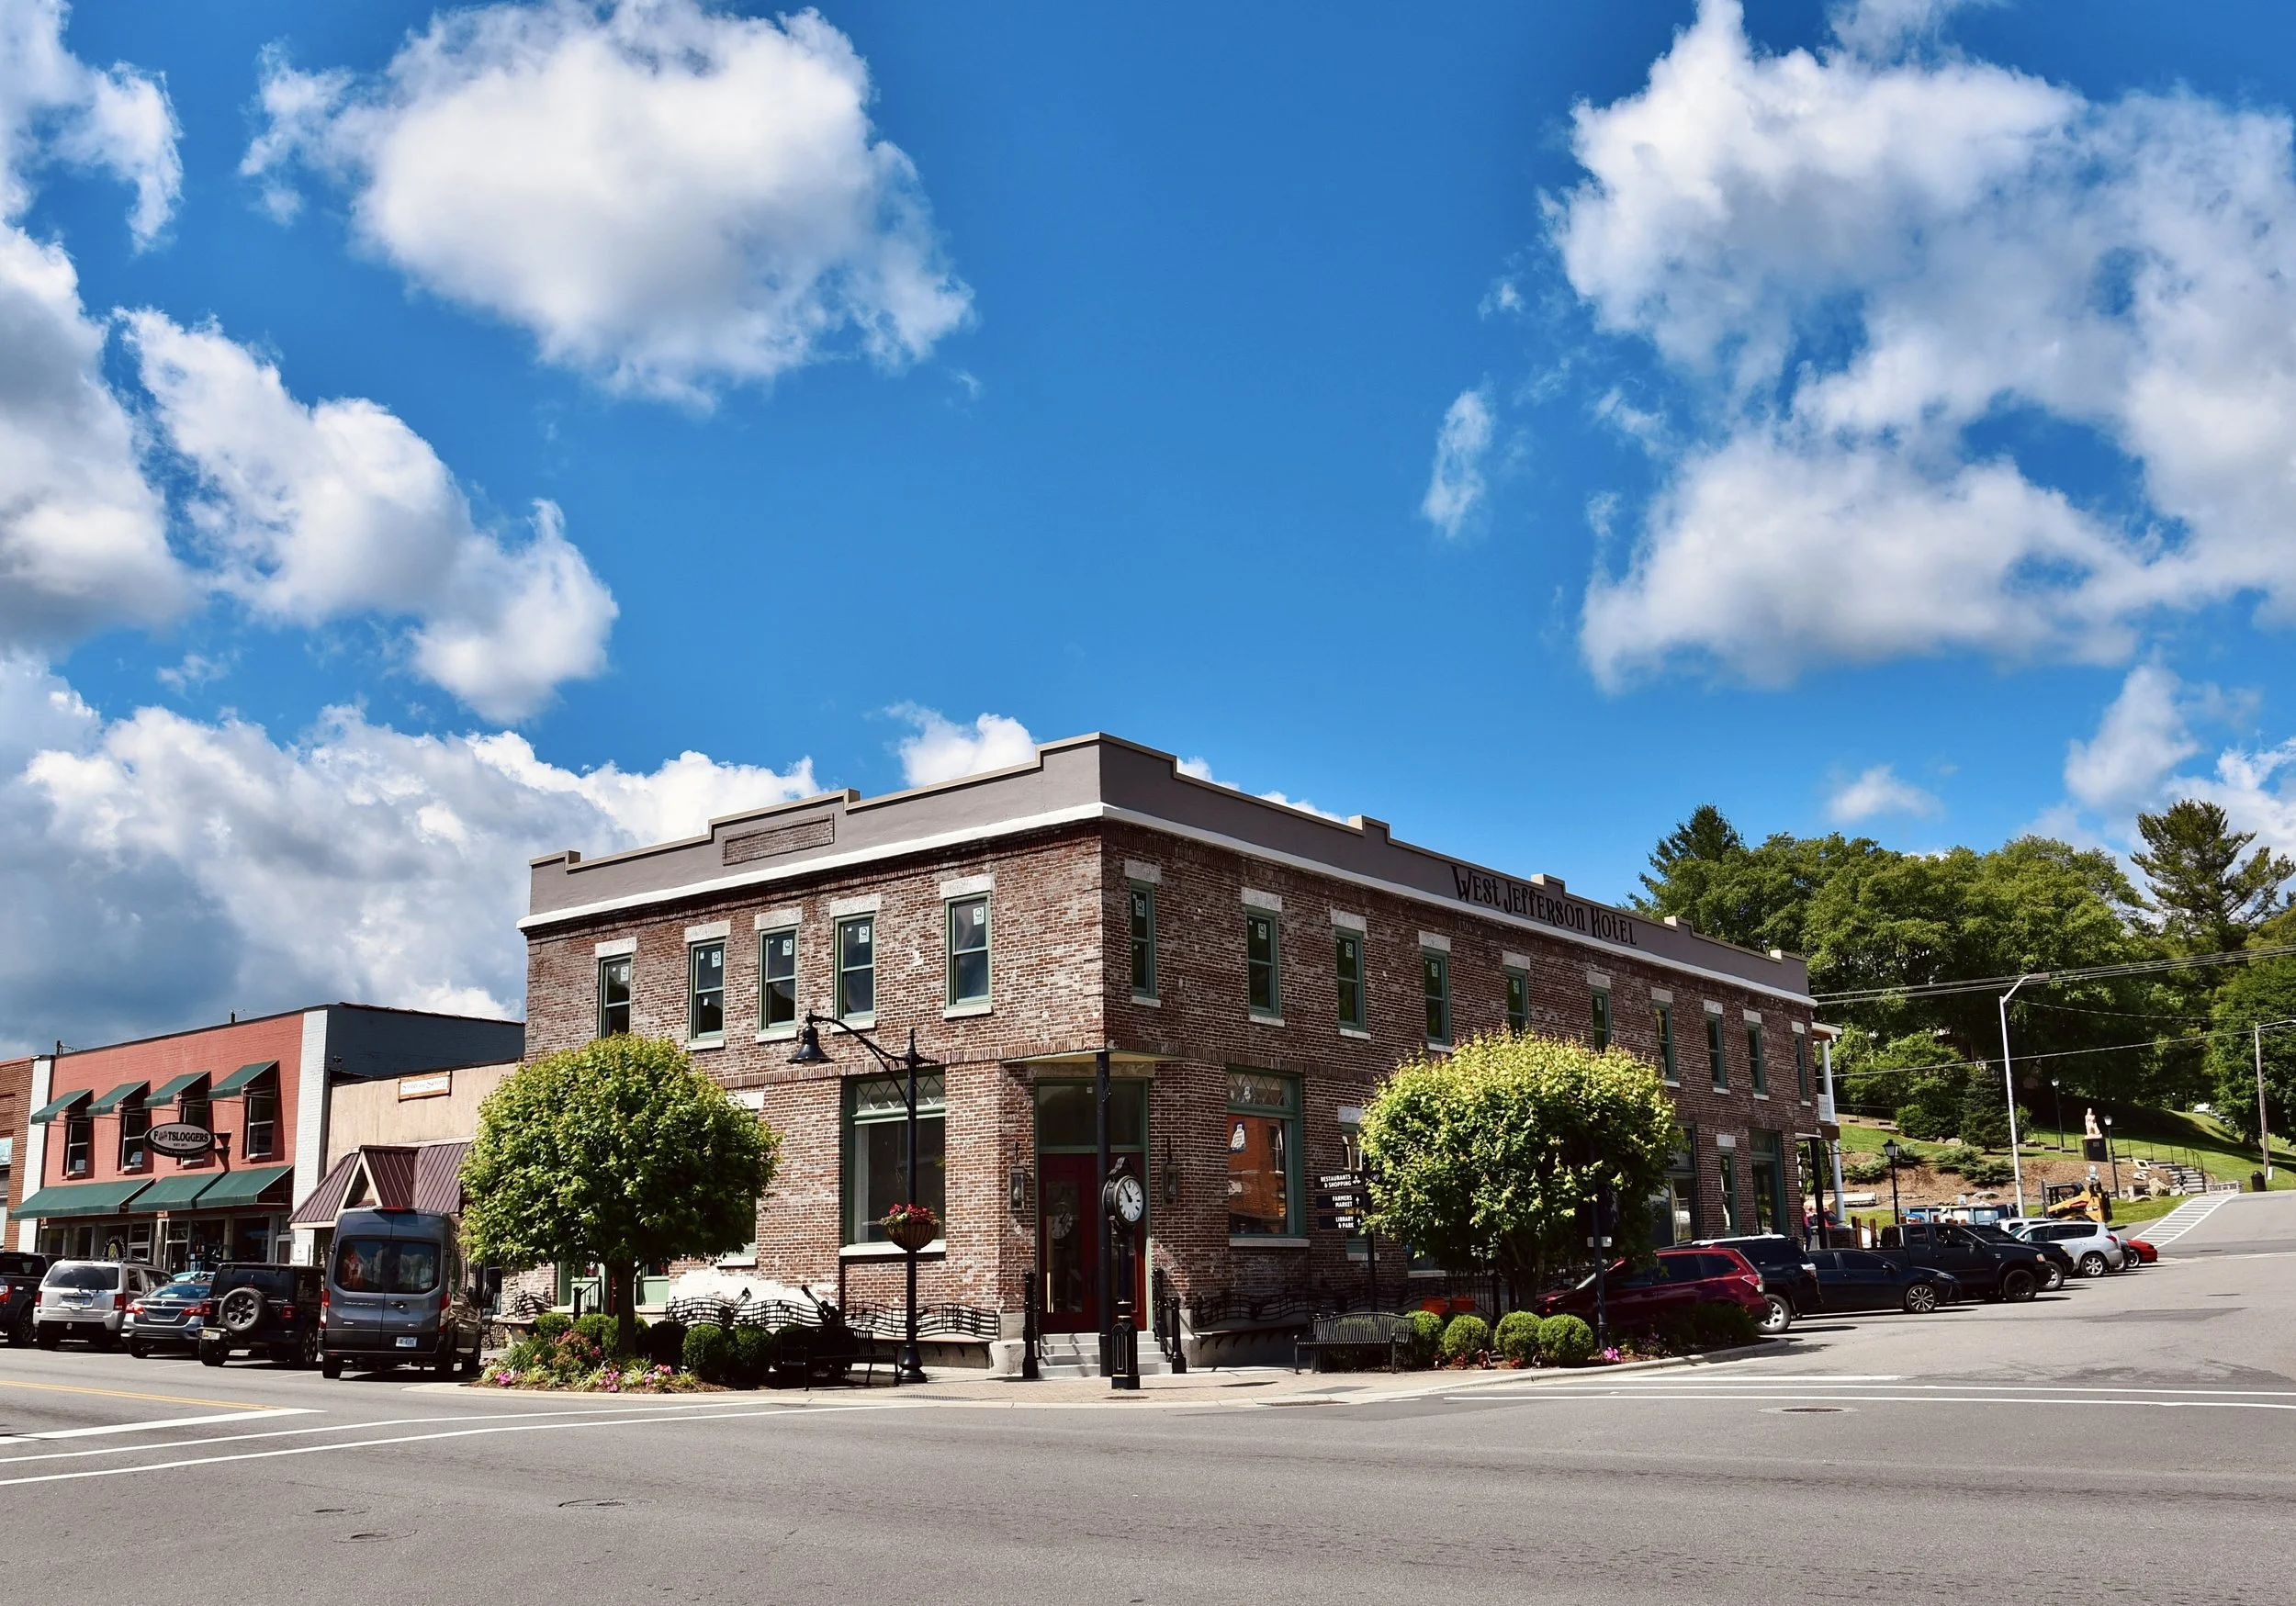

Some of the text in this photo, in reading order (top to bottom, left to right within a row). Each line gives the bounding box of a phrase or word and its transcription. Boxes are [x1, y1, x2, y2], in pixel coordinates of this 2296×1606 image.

[1451, 865, 1637, 946] WEST JEFFERSON HOTEL
